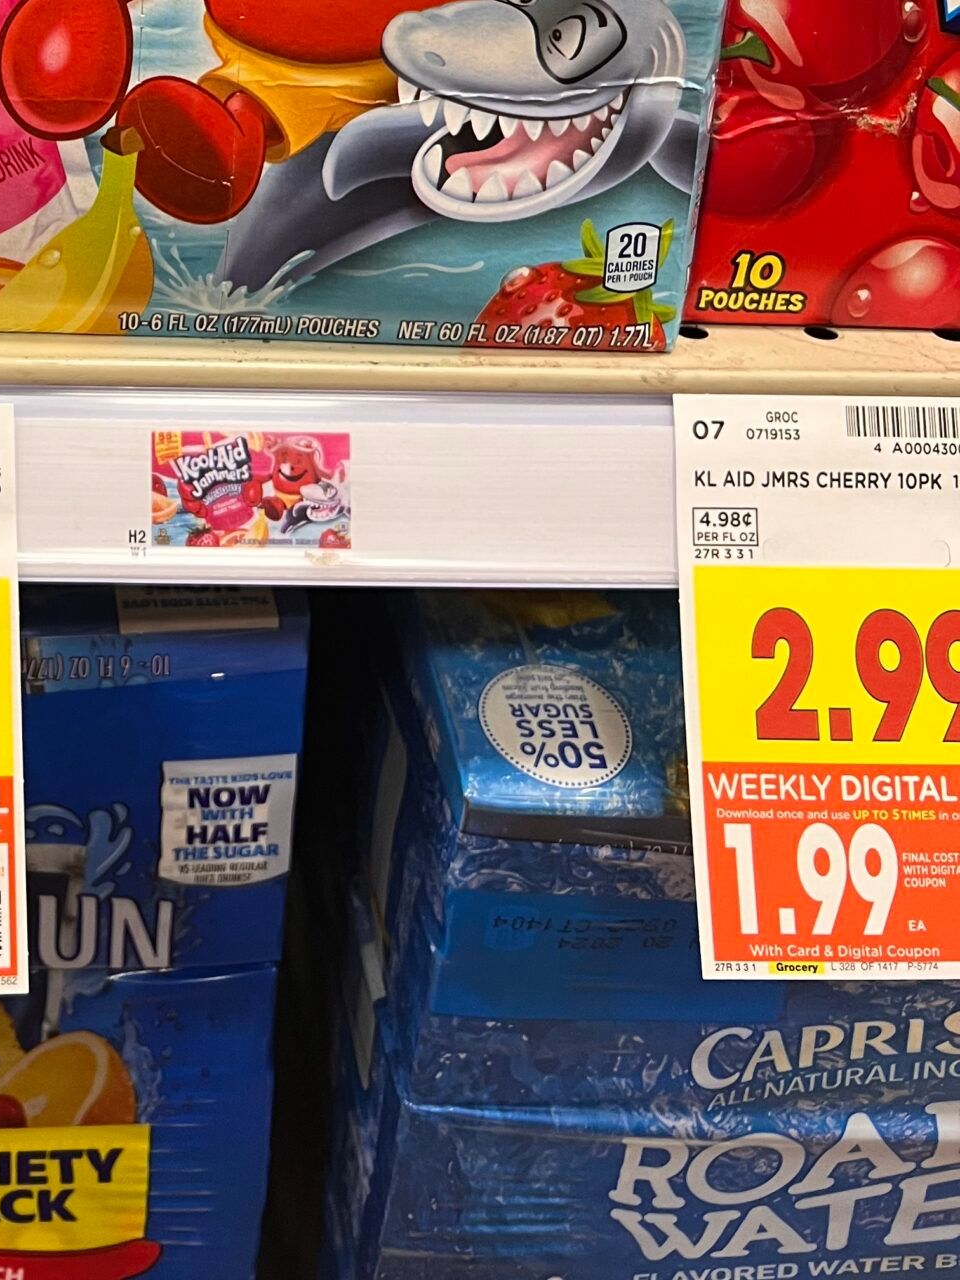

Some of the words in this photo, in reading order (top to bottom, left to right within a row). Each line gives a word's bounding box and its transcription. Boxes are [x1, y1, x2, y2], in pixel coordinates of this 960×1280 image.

[618, 232, 647, 258] 20
[607, 260, 654, 273] CALORIES
[729, 254, 782, 290] 10
[698, 290, 805, 314] POUCHES
[168, 314, 188, 331] FL
[195, 315, 217, 332] OZ
[297, 318, 379, 337] POUCHES
[398, 321, 434, 340] NET
[440, 323, 462, 341] 60
[468, 324, 487, 342] FL
[495, 325, 518, 342] OZ
[766, 411, 798, 423] GROC
[692, 420, 724, 439] 07
[746, 428, 800, 440] 0719153
[695, 471, 716, 486] KL
[723, 471, 754, 487] AID
[761, 471, 810, 488] JMRS
[817, 472, 891, 489] CHERRY
[898, 473, 942, 489] 10PK
[699, 512, 751, 527] 4.98¢
[129, 530, 146, 544] H2
[697, 533, 718, 541] PER
[751, 607, 960, 742] 2.99
[508, 702, 594, 719] SUGAR
[522, 741, 607, 769] 50%
[187, 784, 272, 808] NOW
[708, 774, 831, 800] WEEKLY
[841, 775, 958, 801] DIGITAL
[201, 806, 255, 821] WITH
[716, 808, 774, 820] Download
[186, 822, 269, 844] HALF
[173, 847, 209, 861] THE
[212, 844, 279, 860] SUGAR
[724, 822, 898, 935] 1.99
[903, 865, 928, 875] WITH
[903, 878, 946, 887] COUPON
[749, 945, 784, 957] With
[787, 945, 821, 957] Card
[837, 945, 882, 960] Digital
[887, 946, 940, 960] Coupon
[776, 963, 818, 974] Grocery
[691, 1018, 925, 1090] CAPRI
[807, 1256, 925, 1273] WATER
